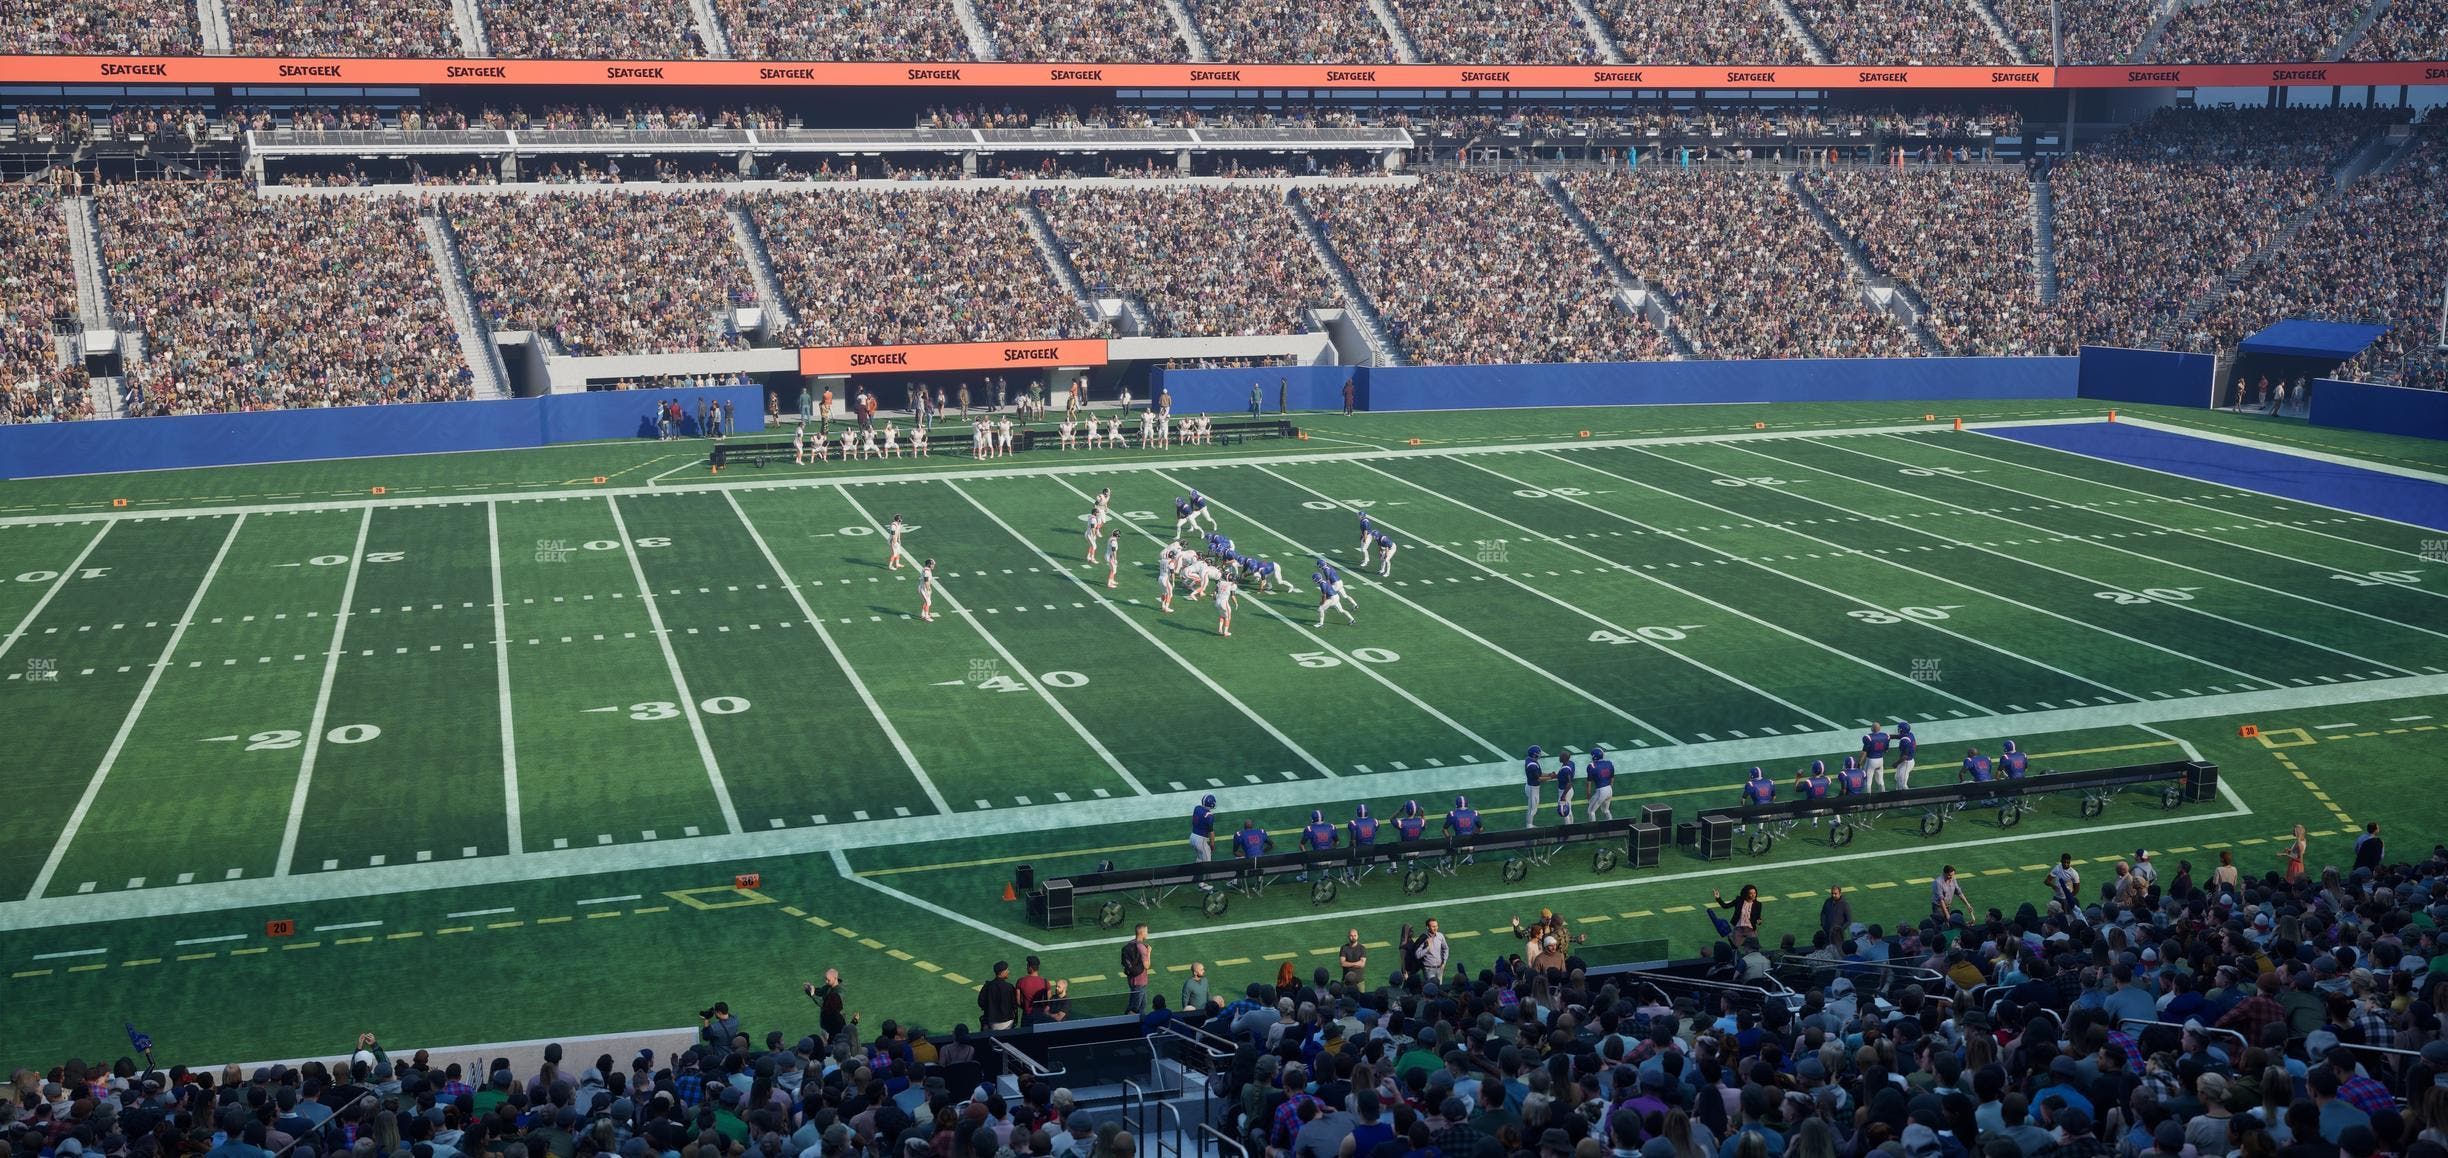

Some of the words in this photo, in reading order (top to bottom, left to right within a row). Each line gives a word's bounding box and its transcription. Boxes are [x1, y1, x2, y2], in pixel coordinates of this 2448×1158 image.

[101, 64, 166, 75] SEATGEEK
[279, 65, 340, 76] SEATGEEK
[447, 67, 505, 77] SEATGEEK
[608, 68, 663, 78] SEATGEEK
[761, 69, 814, 79] SEATGEEK
[909, 70, 960, 79] SEATGEEK
[2273, 69, 2327, 80] SEATGEEK
[1052, 70, 1101, 80] SEATGEEK
[1191, 71, 1239, 80] SEATGEEK
[1327, 71, 1375, 81] SEATGEEK
[1461, 72, 1509, 81] SEATGEEK
[1594, 72, 1641, 81] SEATGEEK
[1728, 73, 1775, 82] SEATGEEK
[1860, 73, 1907, 82] SEATGEEK
[1992, 73, 2039, 82] SEATGEEK
[2128, 71, 2180, 82] SEATGEEK
[850, 352, 907, 366] SEATGEEK
[1004, 347, 1059, 361] SEATGEEK
[2245, 725, 2255, 735] 30
[273, 923, 287, 934] 20
